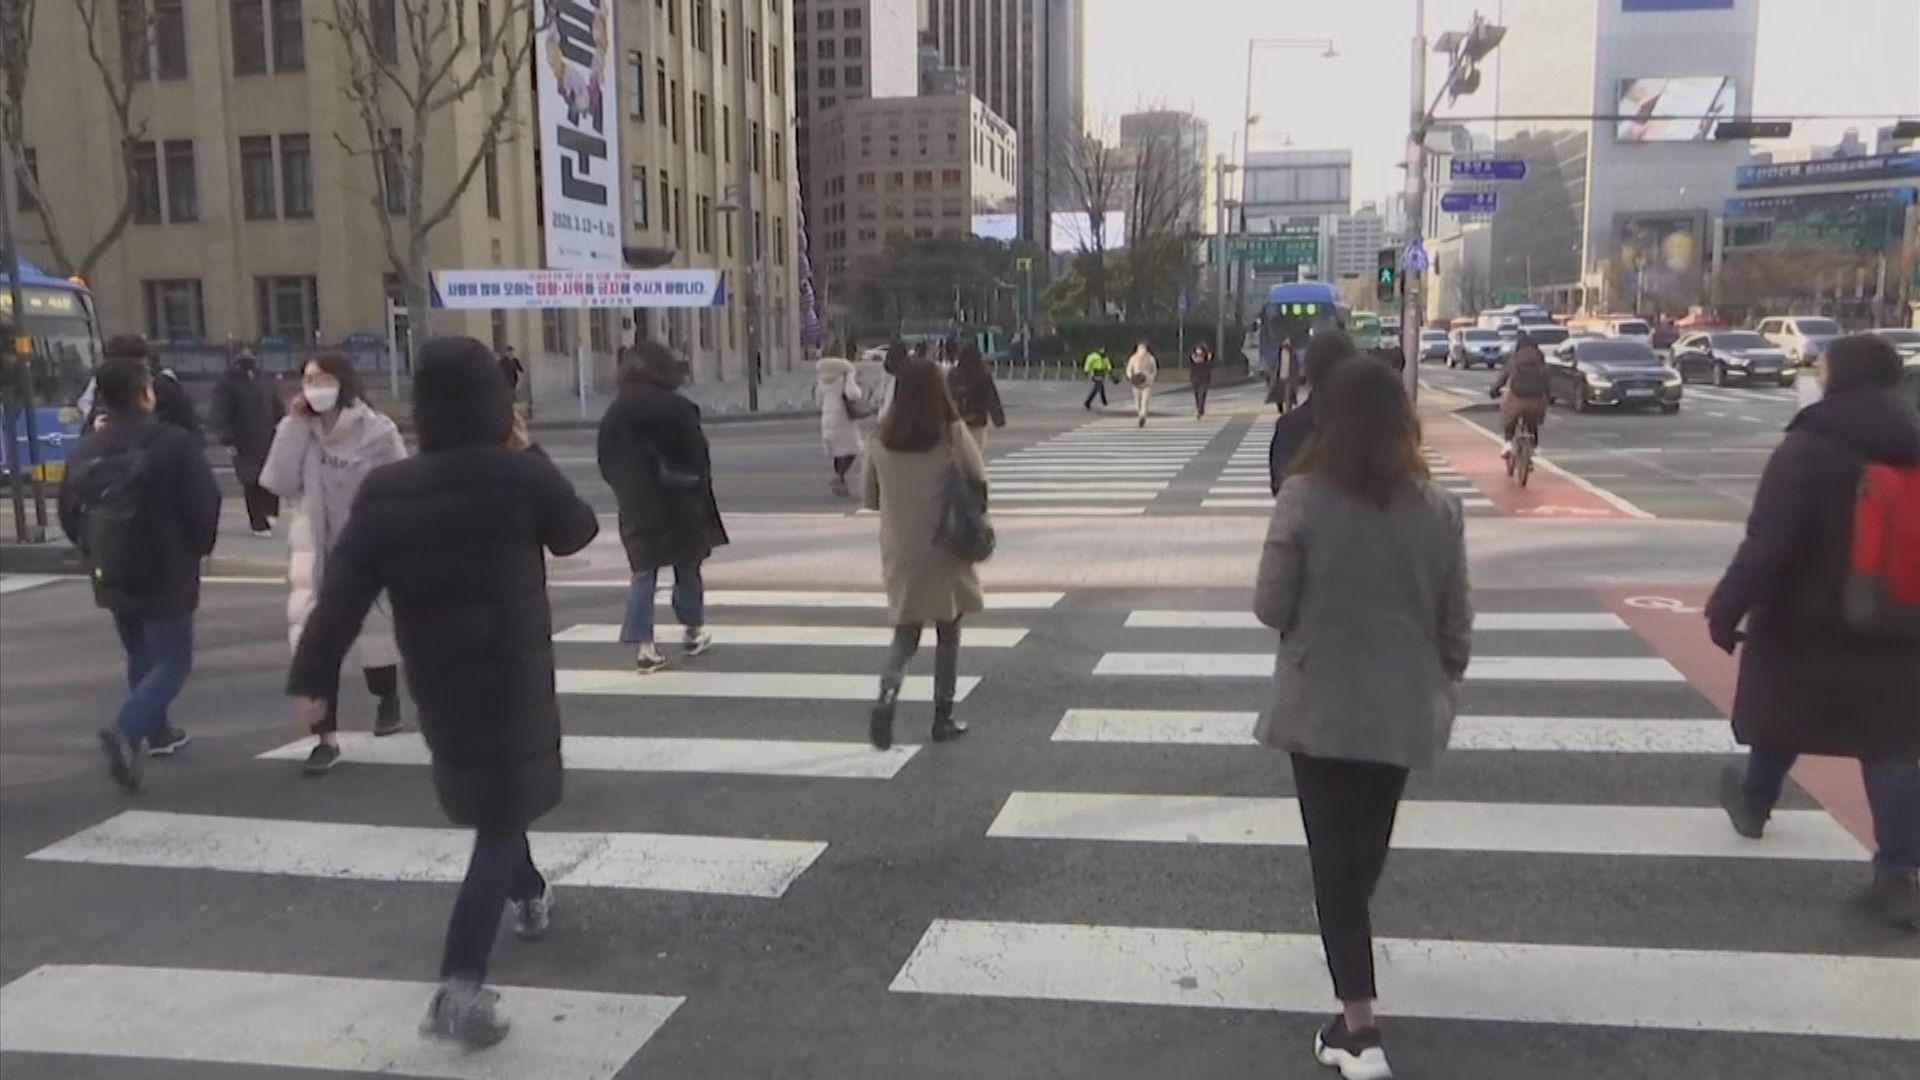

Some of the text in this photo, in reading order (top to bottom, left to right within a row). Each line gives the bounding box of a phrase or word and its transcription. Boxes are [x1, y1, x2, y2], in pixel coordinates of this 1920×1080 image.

[447, 282, 478, 296] 사람이
[503, 282, 534, 296] 모이는
[633, 281, 662, 295] 주시기
